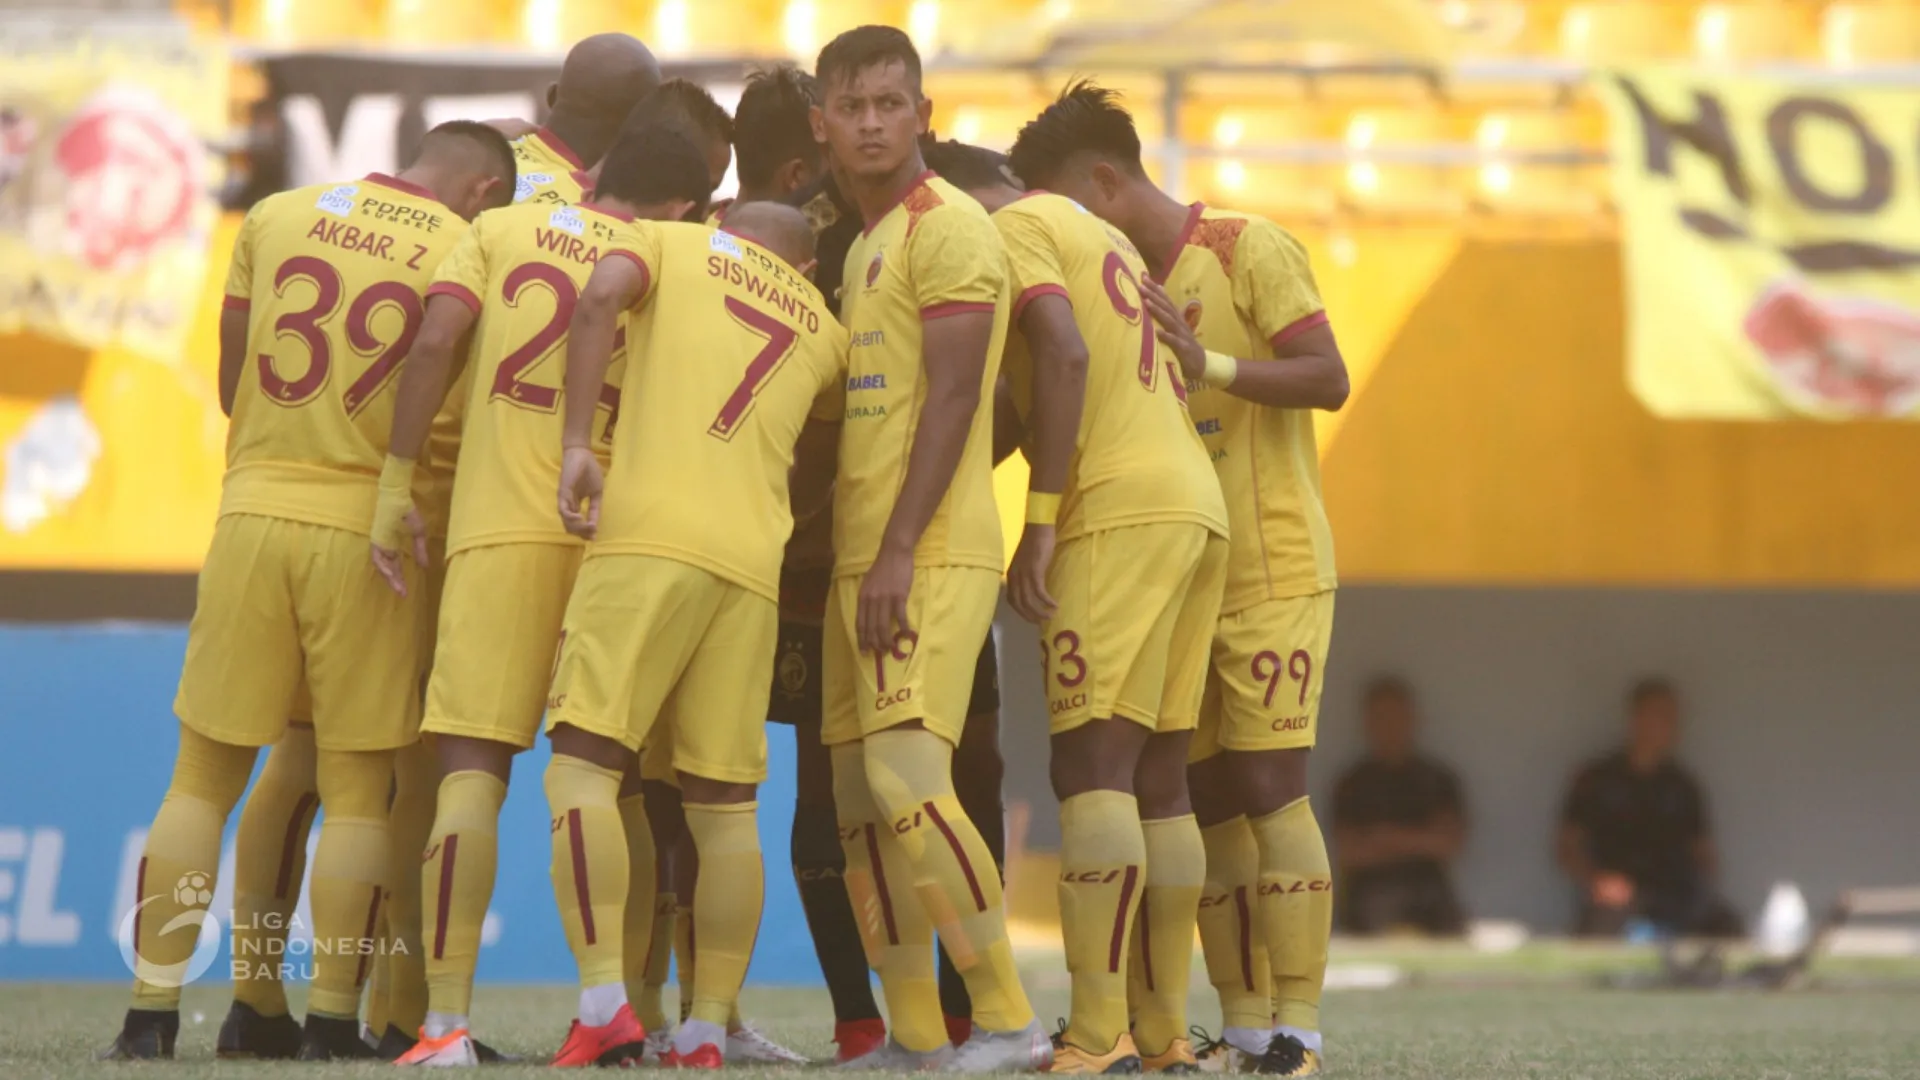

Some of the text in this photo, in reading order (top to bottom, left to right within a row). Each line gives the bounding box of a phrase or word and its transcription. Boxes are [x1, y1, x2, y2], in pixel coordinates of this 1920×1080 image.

[361, 198, 443, 228] PDPDE
[361, 209, 435, 234] SUMSEL
[406, 243, 429, 271] Z
[536, 226, 599, 267] WIRA
[707, 255, 819, 334] SISWANTO
[257, 255, 426, 422] 39
[706, 293, 799, 443] 7
[1251, 649, 1310, 708] 99
[1051, 692, 1087, 715] CALCI
[1271, 715, 1309, 733] CALCI
[1257, 880, 1332, 896] CALCI
